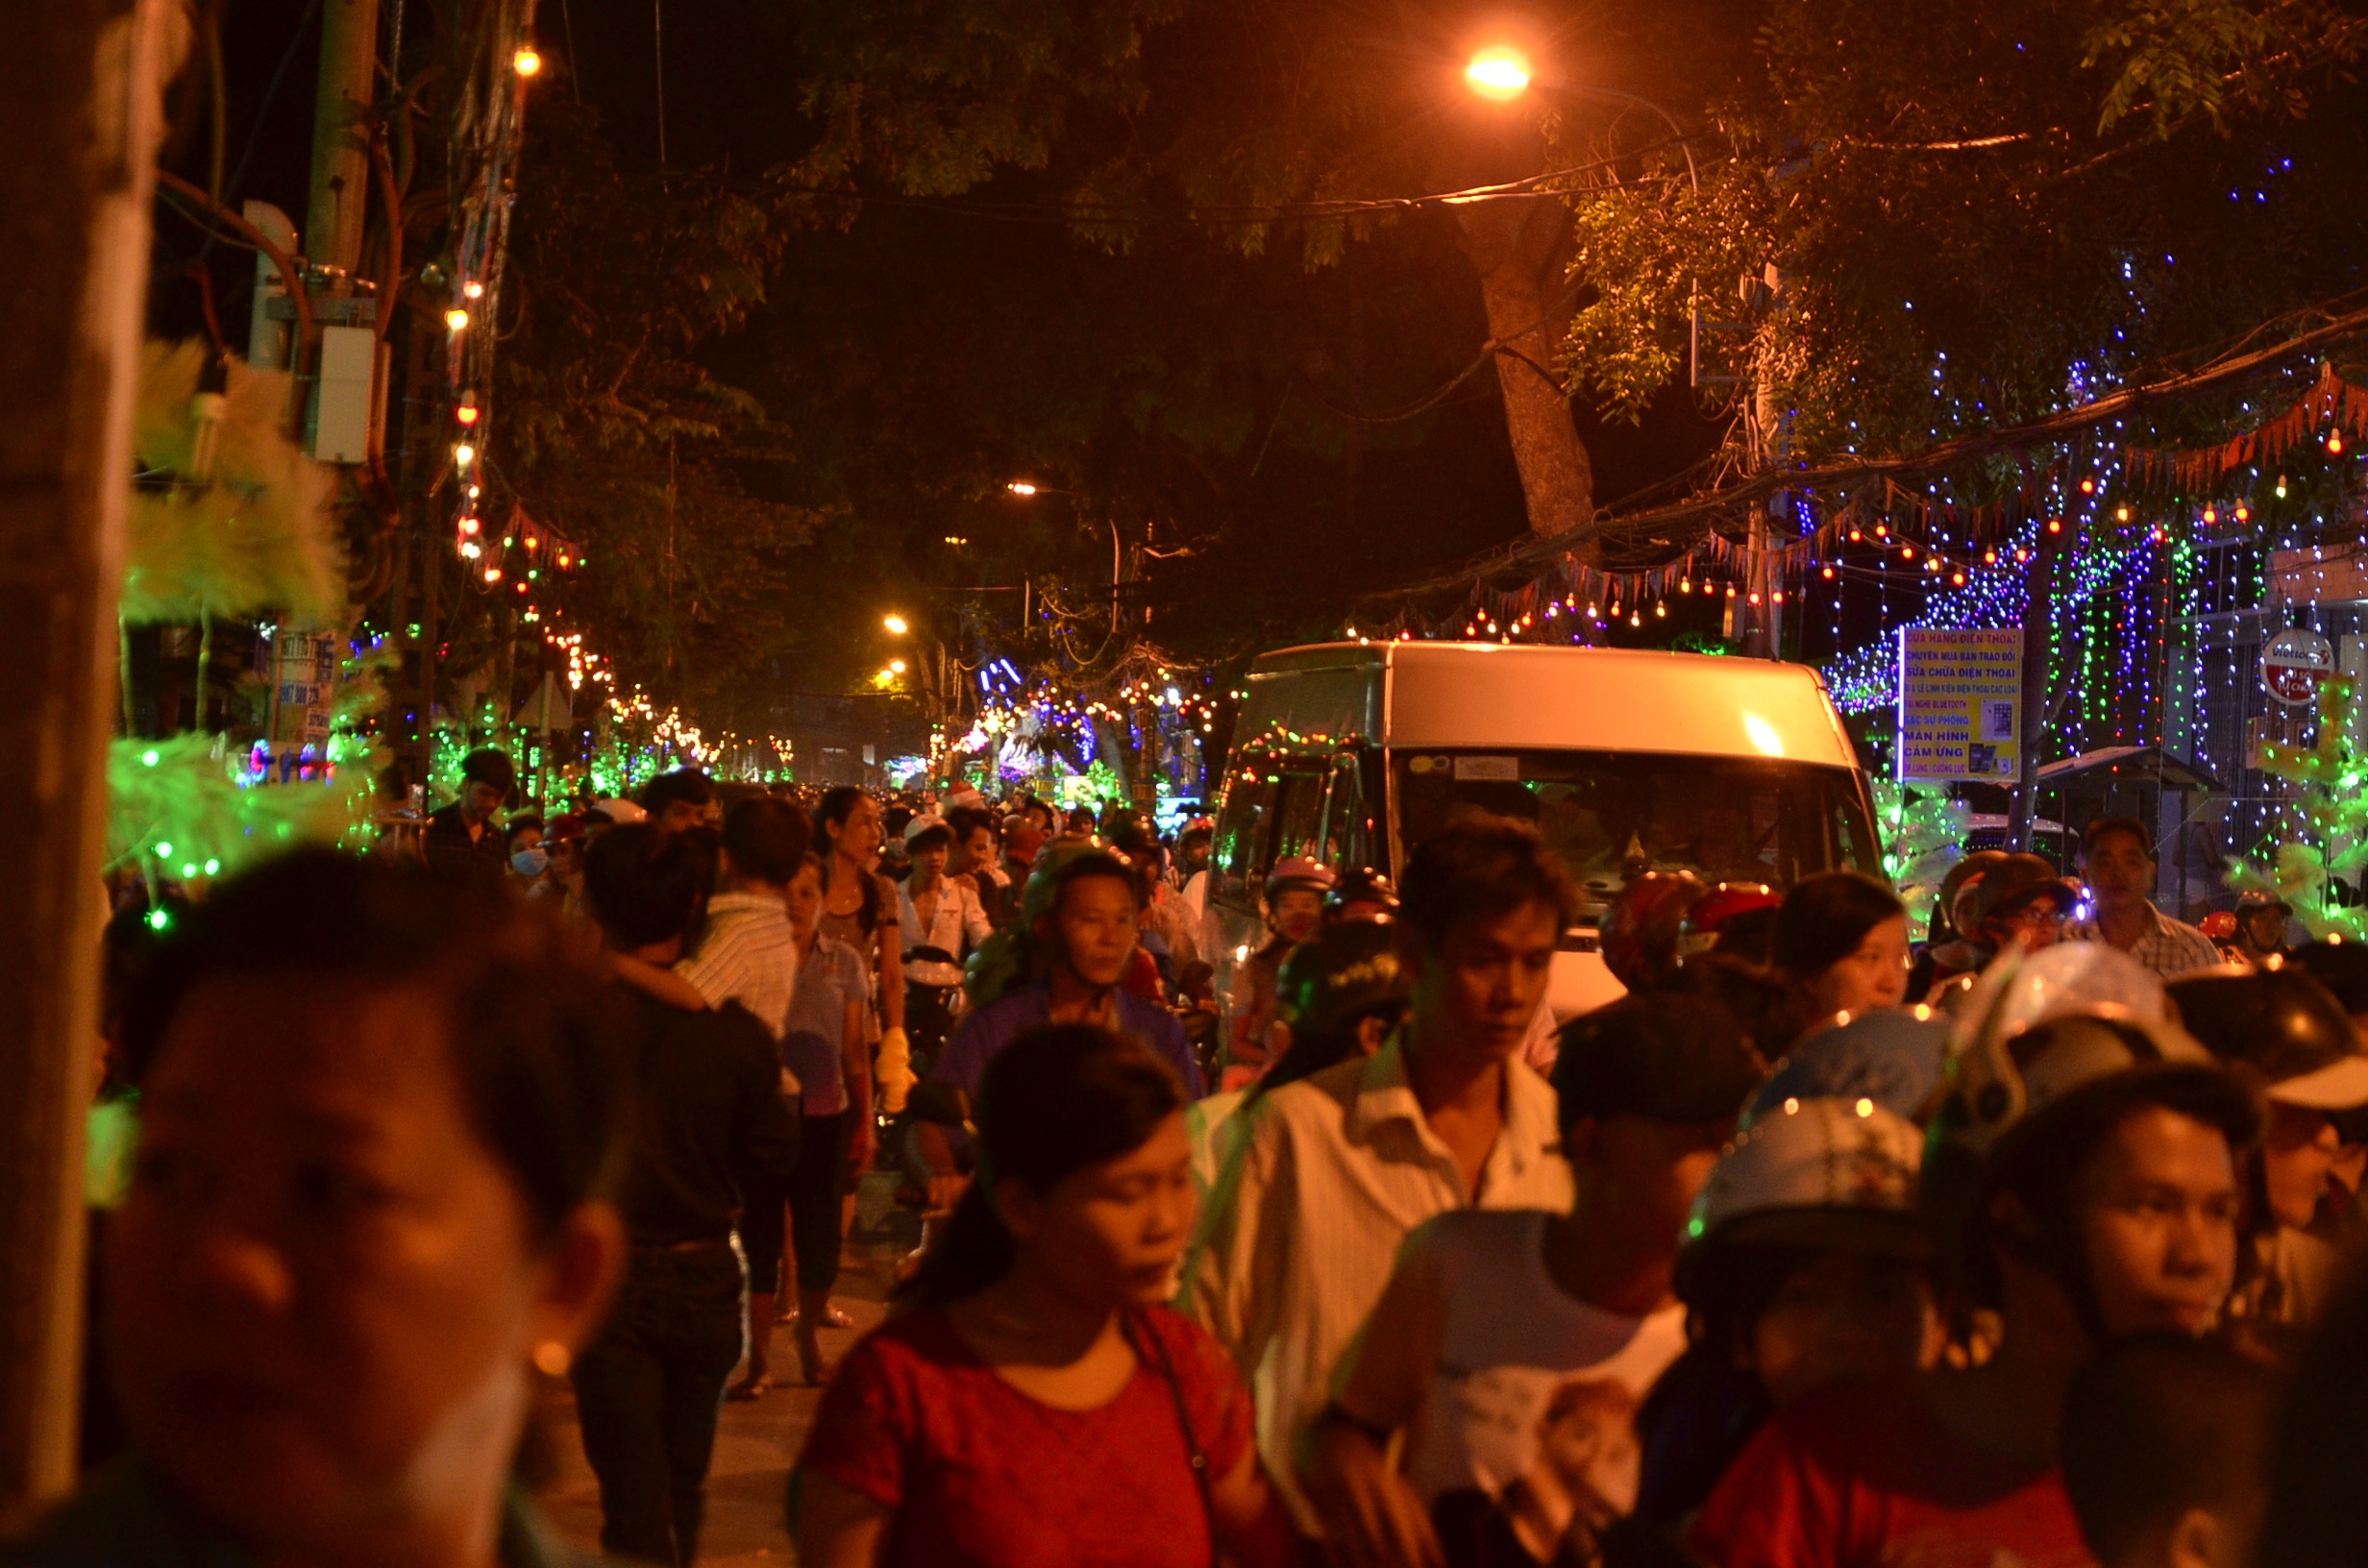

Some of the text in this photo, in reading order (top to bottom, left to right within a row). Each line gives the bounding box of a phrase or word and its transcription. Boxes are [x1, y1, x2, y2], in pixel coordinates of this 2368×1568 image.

[1941, 651, 1958, 660] MUA
[1980, 651, 2000, 661] TRAO
[1986, 668, 2015, 680] THOẠI
